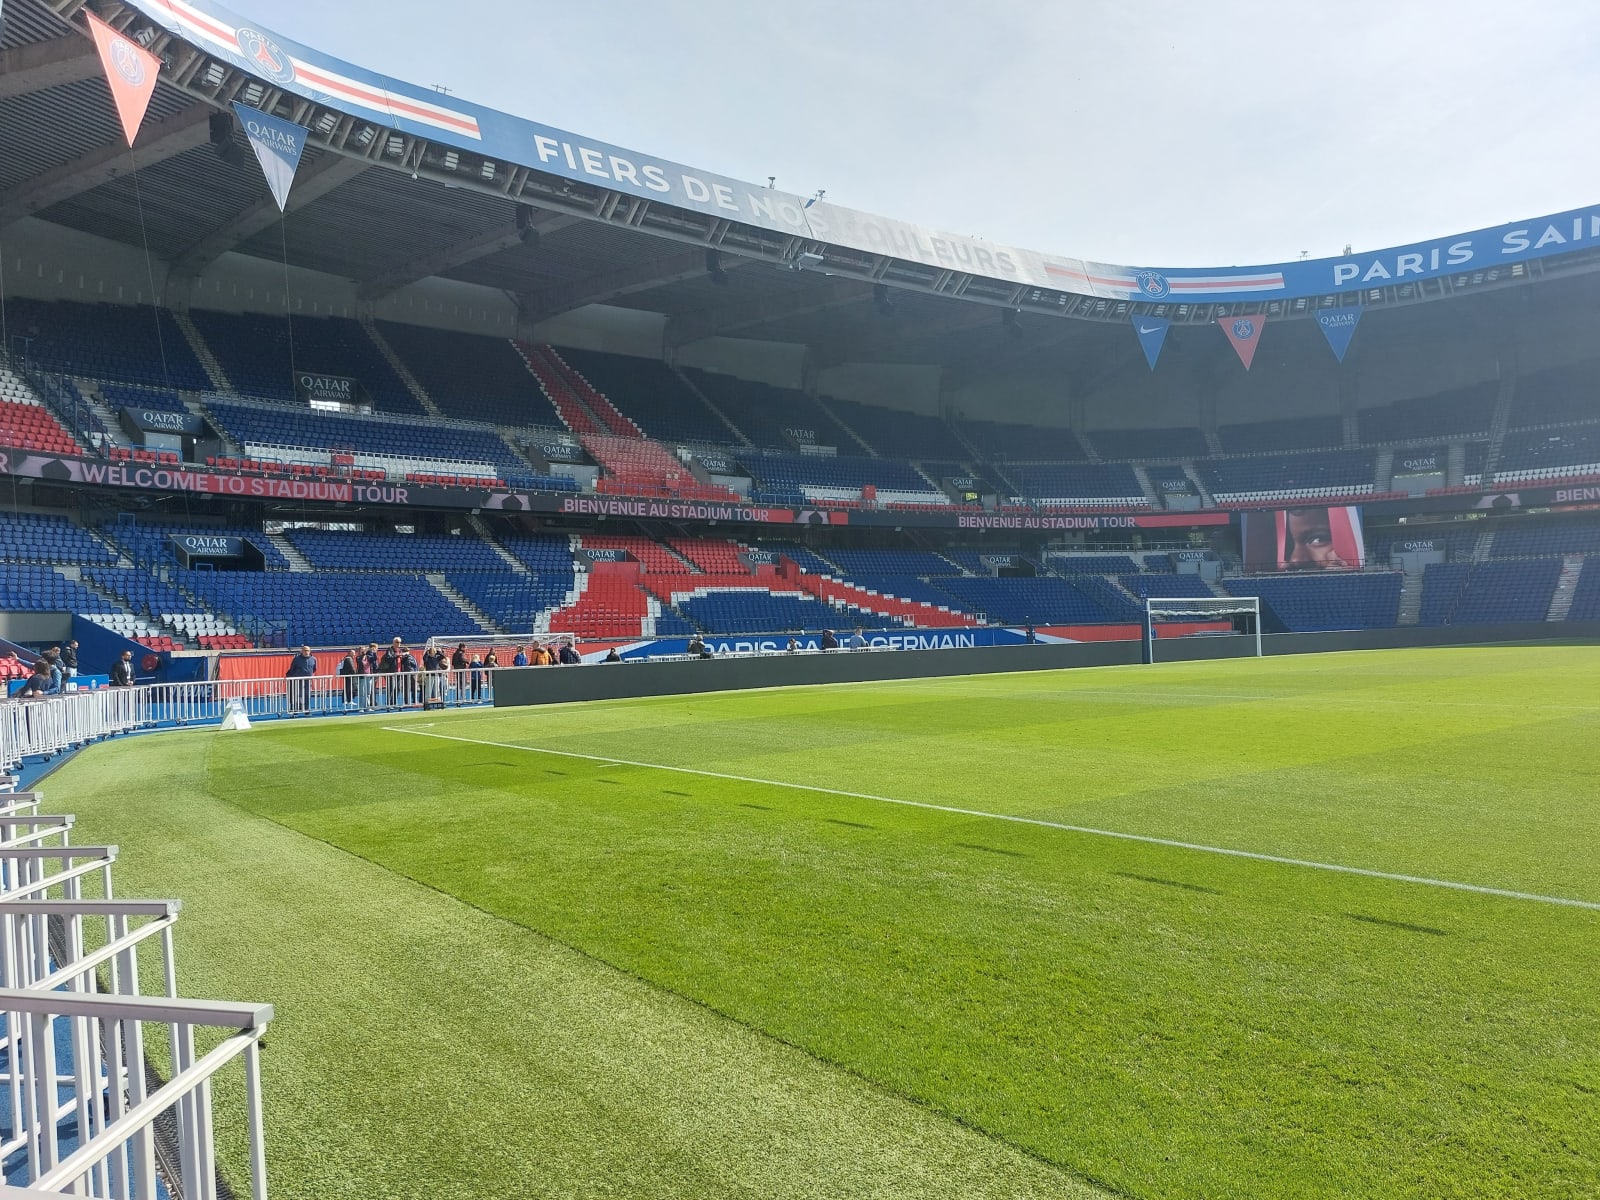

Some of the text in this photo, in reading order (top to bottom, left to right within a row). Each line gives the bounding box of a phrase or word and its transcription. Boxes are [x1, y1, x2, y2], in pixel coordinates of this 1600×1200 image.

[247, 121, 296, 148] QATAR
[261, 138, 297, 155] AIRWAYS
[533, 134, 1017, 273] FIERS DE NOS OULEURS
[1333, 241, 1474, 286] PARIS
[1320, 313, 1354, 325] QATAR
[301, 376, 350, 393] QATAR
[313, 390, 351, 400] AIRWAYS
[143, 411, 184, 425] QATAR
[153, 421, 185, 431] AIRWAYS
[543, 445, 571, 455] QATAR
[702, 458, 727, 469] QATAR
[1403, 457, 1436, 469] QATAR
[80, 462, 409, 504] WELCOME TO STADIUM TOUR
[564, 498, 769, 522] BIENVENUE AU STADIUM TOUR
[958, 516, 1136, 529] BIENVENUE AU STADIUM TOUR
[186, 536, 228, 549] QATAR
[1404, 540, 1434, 550] QATAR
[587, 549, 616, 559] QATAR
[748, 552, 772, 562] QATAR
[1179, 552, 1204, 560] QATAR
[990, 556, 1011, 565] QATAR
[870, 633, 975, 650] GERMAIN
